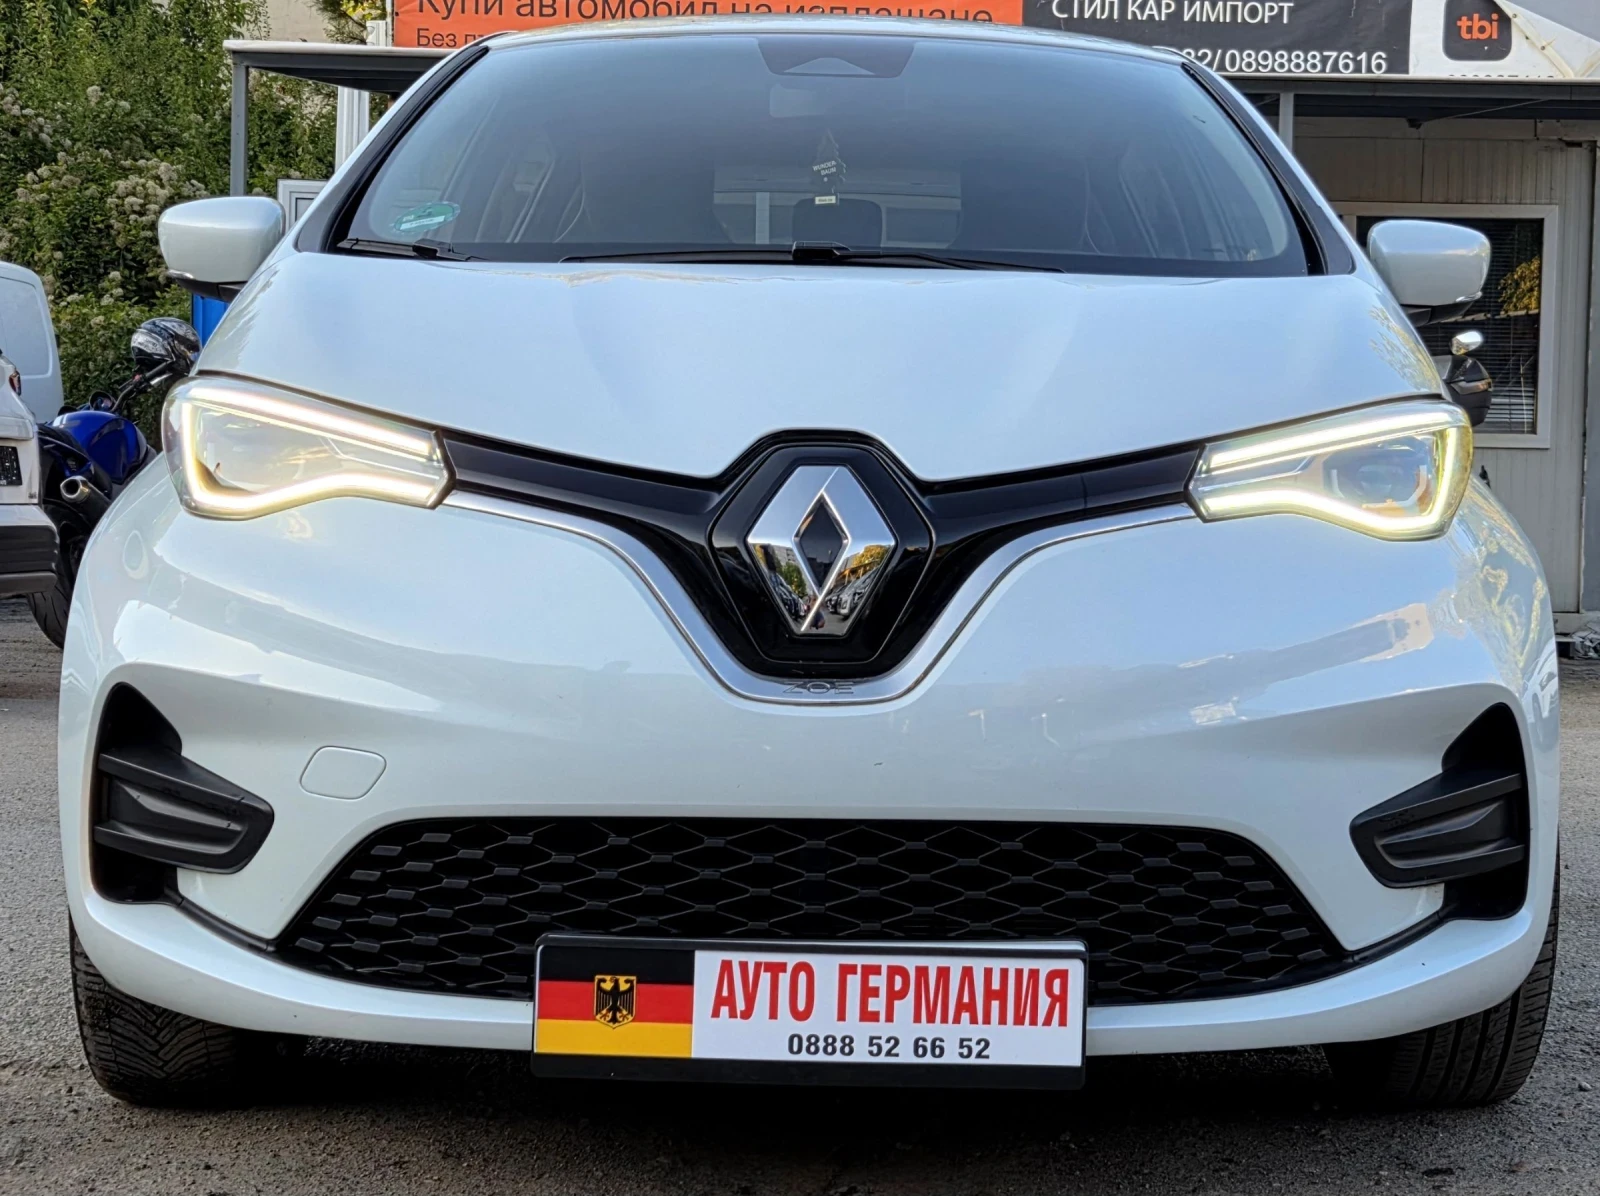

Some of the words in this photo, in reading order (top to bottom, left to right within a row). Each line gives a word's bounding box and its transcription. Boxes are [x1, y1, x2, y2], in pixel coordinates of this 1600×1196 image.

[1051, 0, 1118, 19] СТИЛ
[1127, 0, 1175, 21] КАР
[1183, 0, 1294, 24] ИМПОРТ
[417, 28, 457, 48] Без
[1456, 13, 1499, 40] tbi
[782, 681, 854, 695] ZOE
[711, 959, 815, 1022] АУТО
[837, 963, 1069, 1027] ГЕРМАНИЯ
[788, 1033, 855, 1057] 0888
[867, 1035, 900, 1058] 52
[913, 1036, 945, 1059] 66
[958, 1037, 991, 1060] 52
